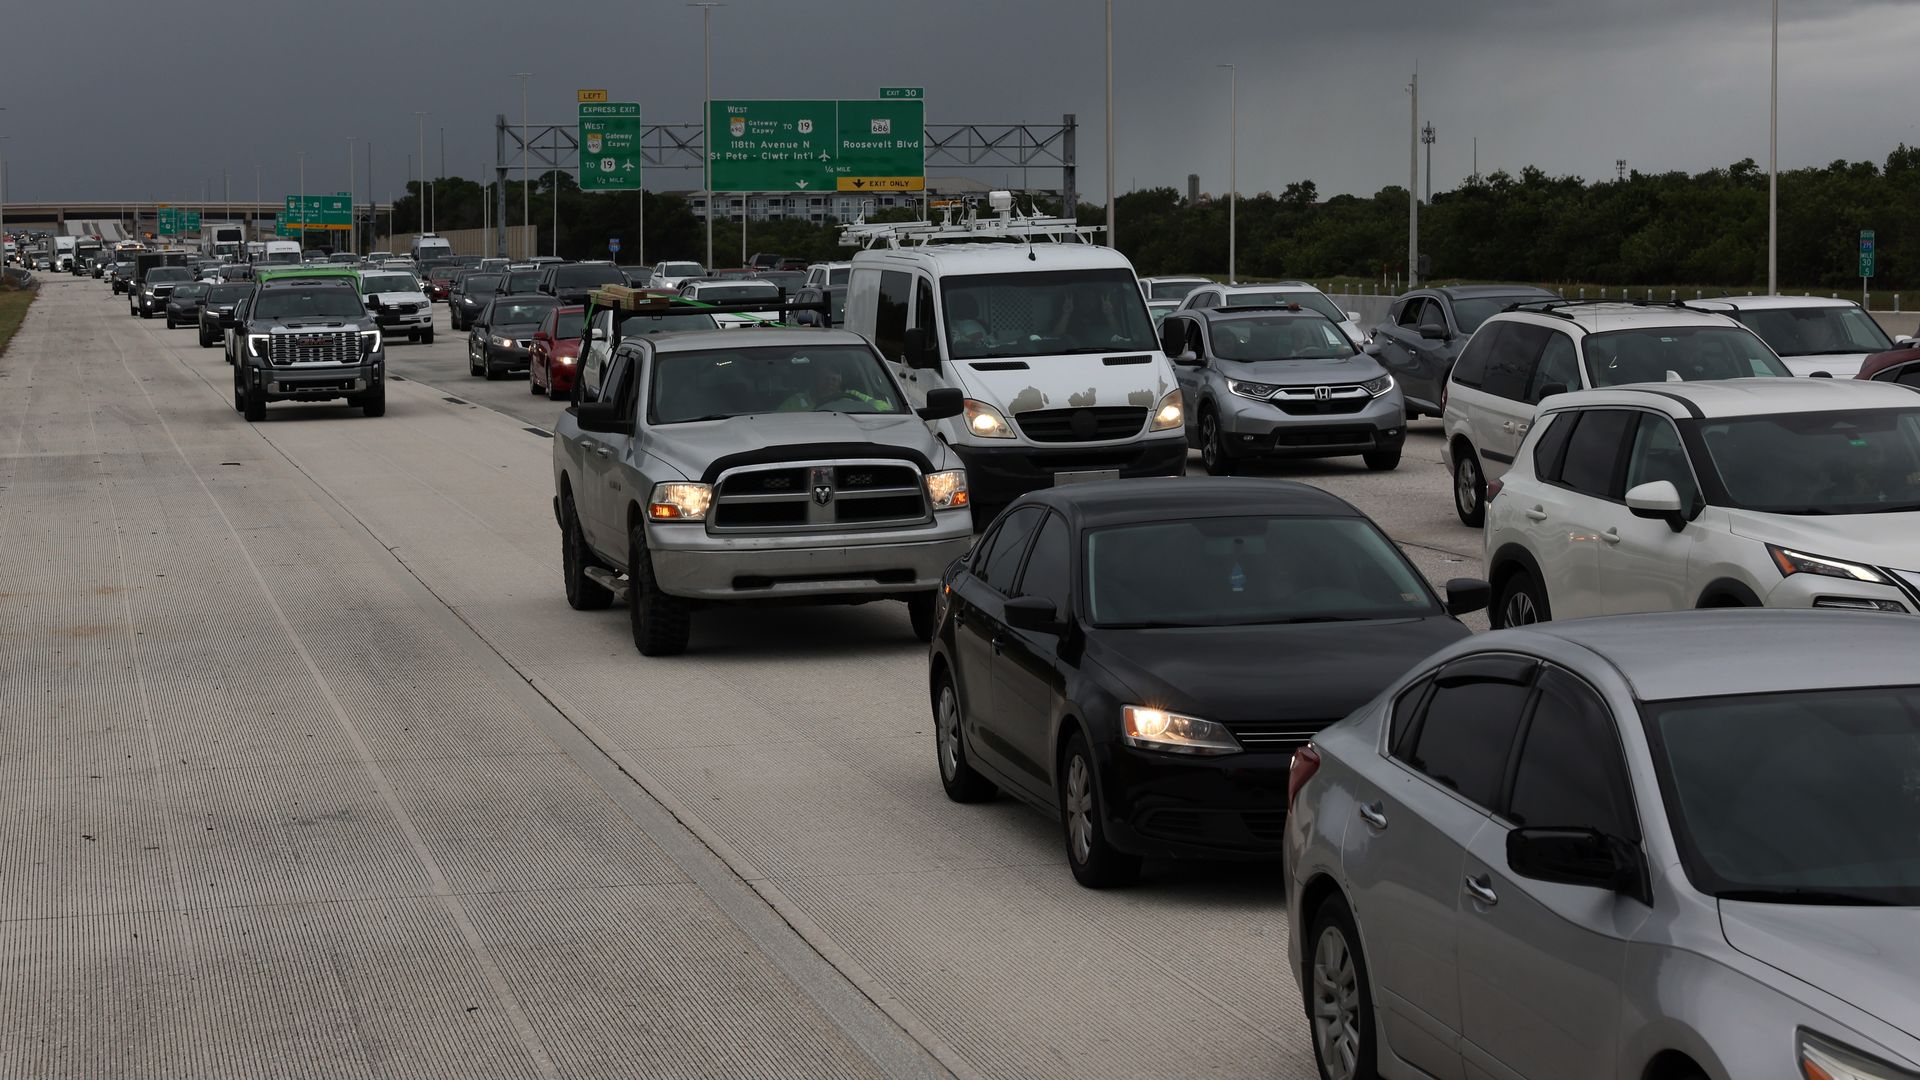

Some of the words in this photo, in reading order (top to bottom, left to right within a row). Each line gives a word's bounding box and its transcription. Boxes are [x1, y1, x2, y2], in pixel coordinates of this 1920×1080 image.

[905, 89, 916, 97] 30
[748, 119, 777, 127] Gateway
[800, 122, 809, 130] 19
[872, 124, 888, 132] 686
[605, 132, 632, 140] Gateway
[607, 140, 630, 148] Expwy
[730, 140, 755, 149] 118th
[760, 140, 798, 149] Avenue
[802, 140, 810, 149] N
[843, 140, 892, 149] Roosevelt
[896, 140, 918, 149] Blvd
[710, 152, 721, 160] St
[725, 152, 748, 160] Pete
[761, 152, 789, 160] Clwtr
[793, 152, 813, 160] Int'l
[603, 160, 612, 168] 19
[1862, 258, 1871, 266] 30
